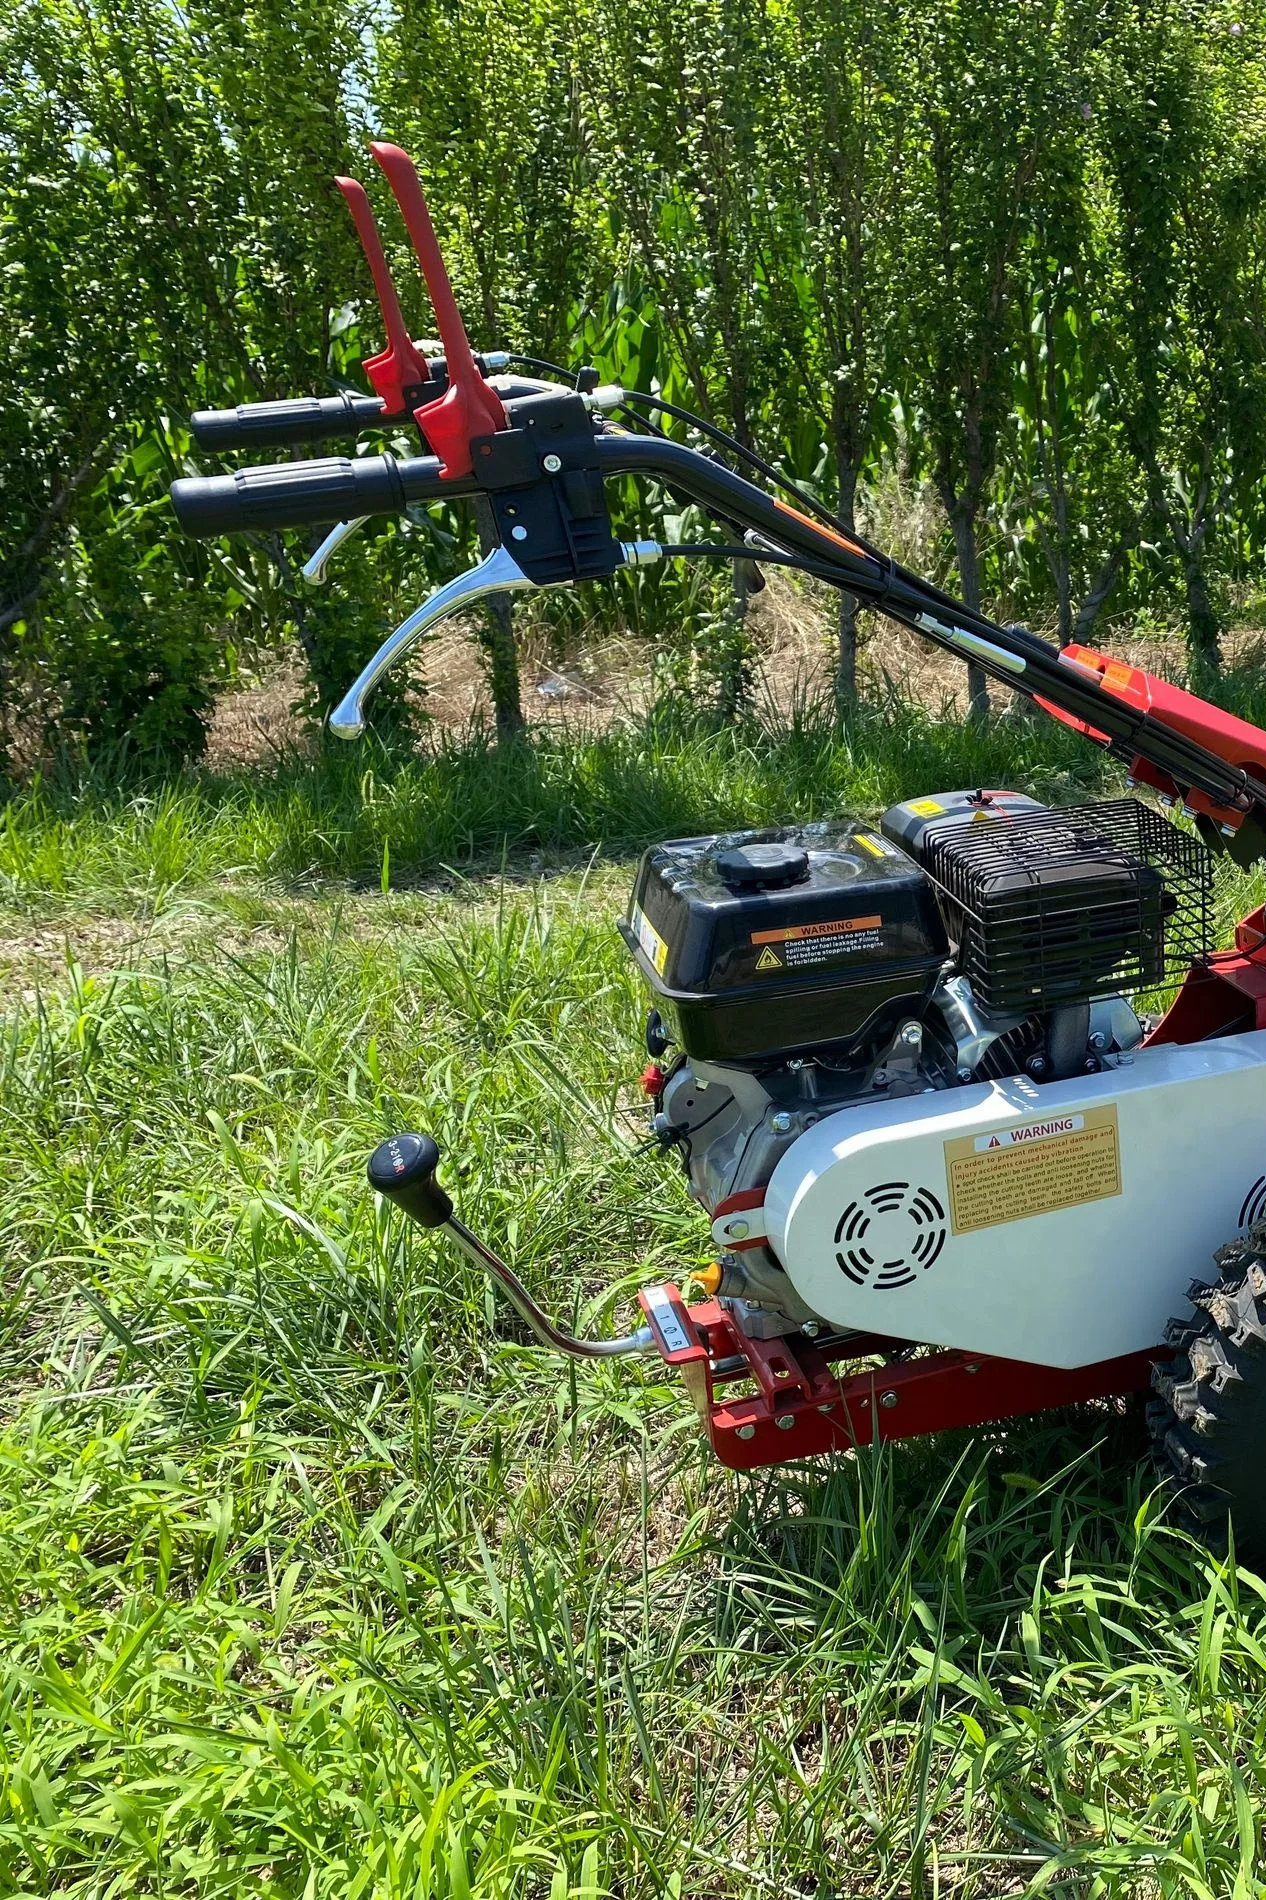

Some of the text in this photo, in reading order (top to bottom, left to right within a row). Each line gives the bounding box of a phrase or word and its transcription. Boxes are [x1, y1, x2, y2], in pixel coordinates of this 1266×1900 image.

[801, 921, 853, 935] WARNING
[822, 947, 850, 955] stopping
[1011, 1119, 1072, 1141] WARNING
[955, 1171, 977, 1180] injury
[979, 1163, 1013, 1174] accidents
[1015, 1155, 1040, 1166] caused
[1051, 1146, 1083, 1157] vibration
[964, 1160, 984, 1168] order
[997, 1150, 1025, 1162] prevent
[1028, 1140, 1068, 1153] mechanical
[1070, 1134, 1097, 1144] damage
[1100, 1129, 1113, 1137] and
[956, 1187, 976, 1196] check
[978, 1181, 1003, 1190] whether
[1016, 1174, 1032, 1182] bolts
[1033, 1170, 1046, 1178] and
[1047, 1167, 1059, 1175] anti
[1060, 1160, 1090, 1171] loosening
[977, 1175, 995, 1183] check
[1021, 1162, 1043, 1172] carried
[1056, 1156, 1076, 1164] before
[1078, 1149, 1106, 1160] operation
[1001, 1184, 1023, 1193] cutting
[1025, 1179, 1041, 1187] teeth
[1090, 1162, 1114, 1171] whether
[971, 1199, 993, 1208] cutting
[996, 1194, 1012, 1202] teeth
[1028, 1183, 1057, 1194] damaged
[1060, 1179, 1071, 1187] and
[1098, 1169, 1115, 1177] When
